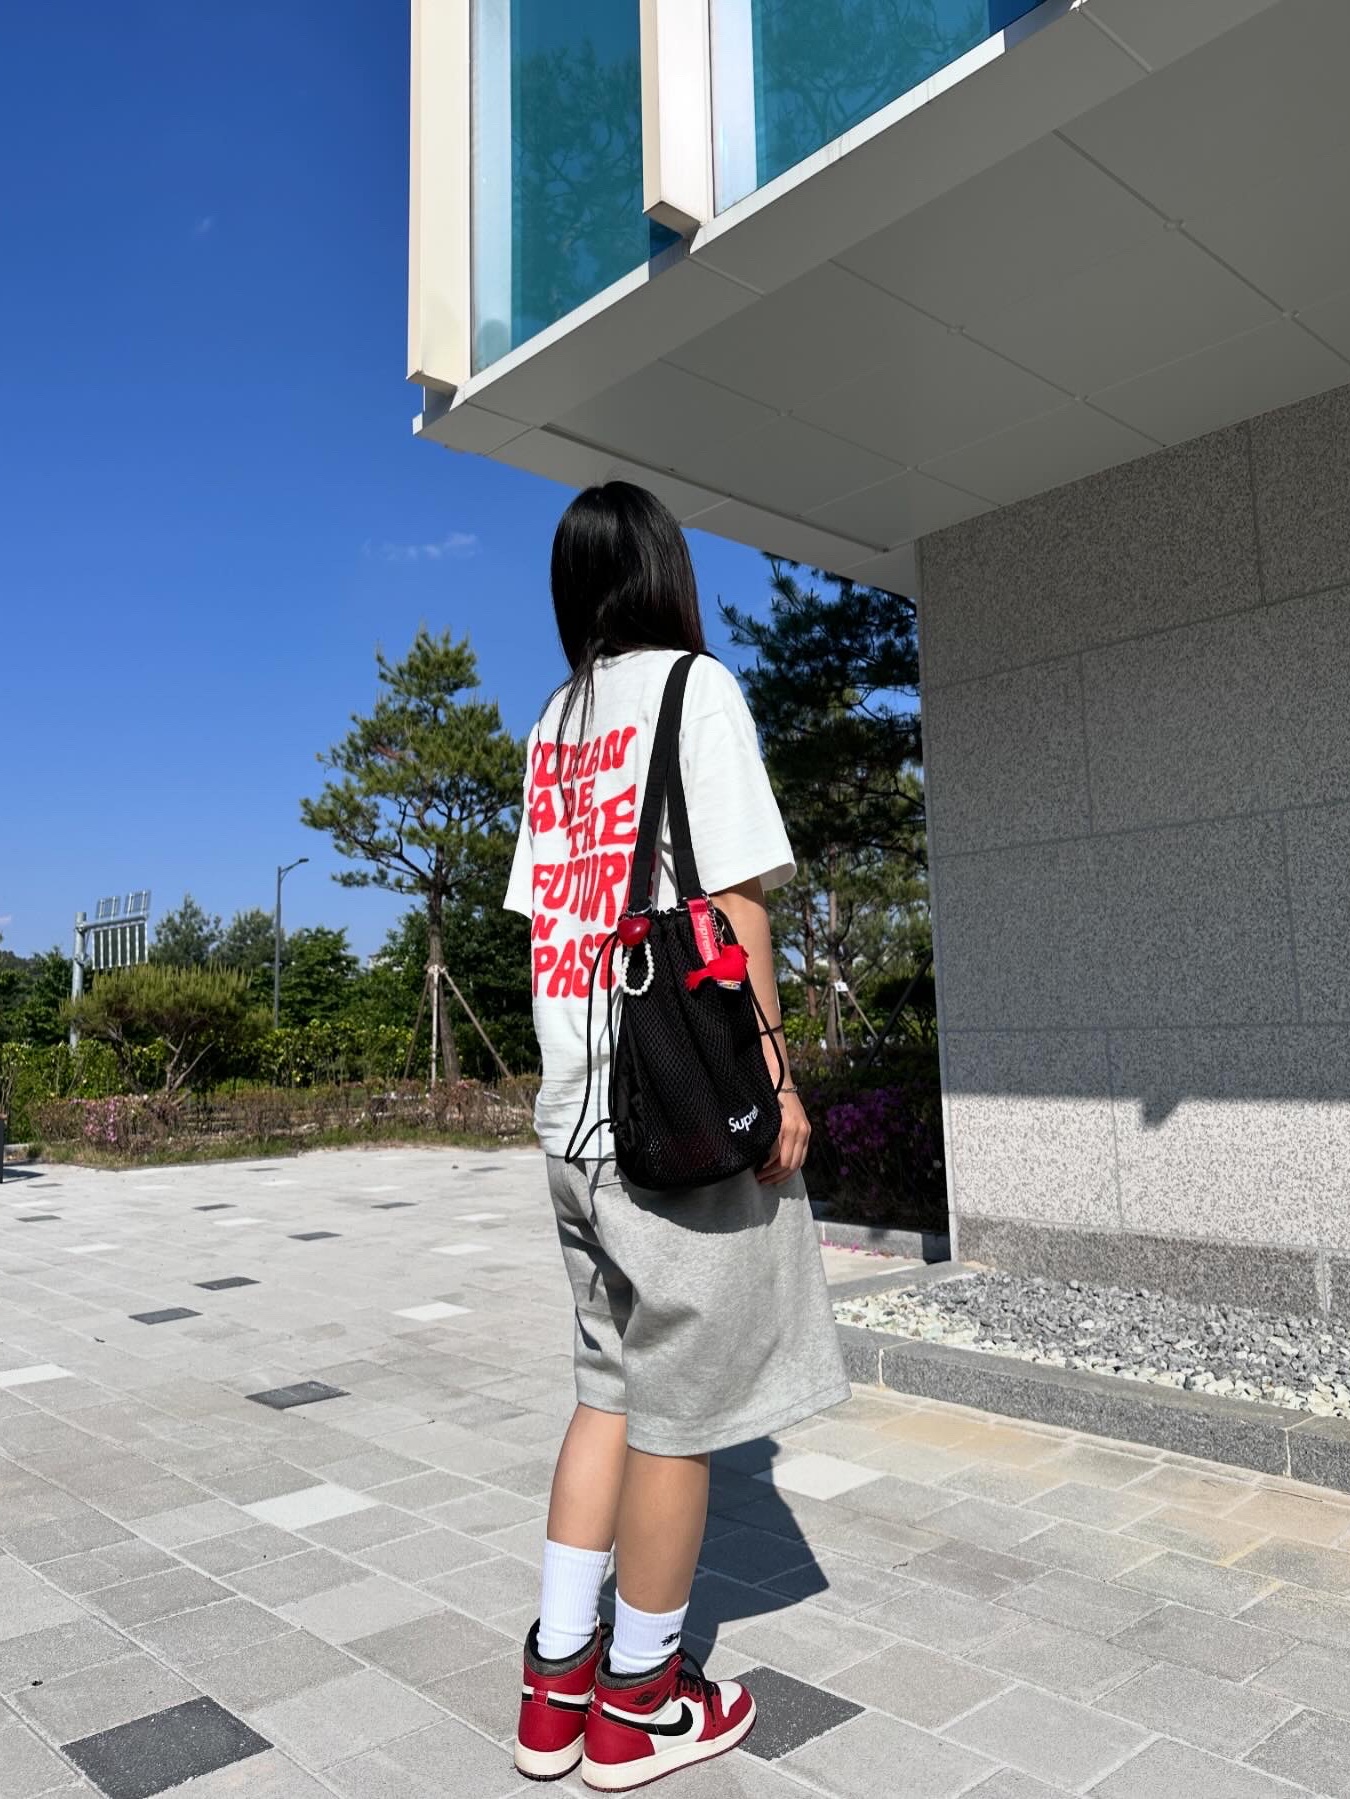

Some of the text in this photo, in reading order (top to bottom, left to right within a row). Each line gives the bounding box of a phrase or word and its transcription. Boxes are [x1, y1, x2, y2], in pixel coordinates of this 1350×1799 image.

[566, 784, 637, 858] THE
[533, 852, 634, 928] FUTUR
[531, 911, 558, 941] N
[533, 933, 623, 998] PAST
